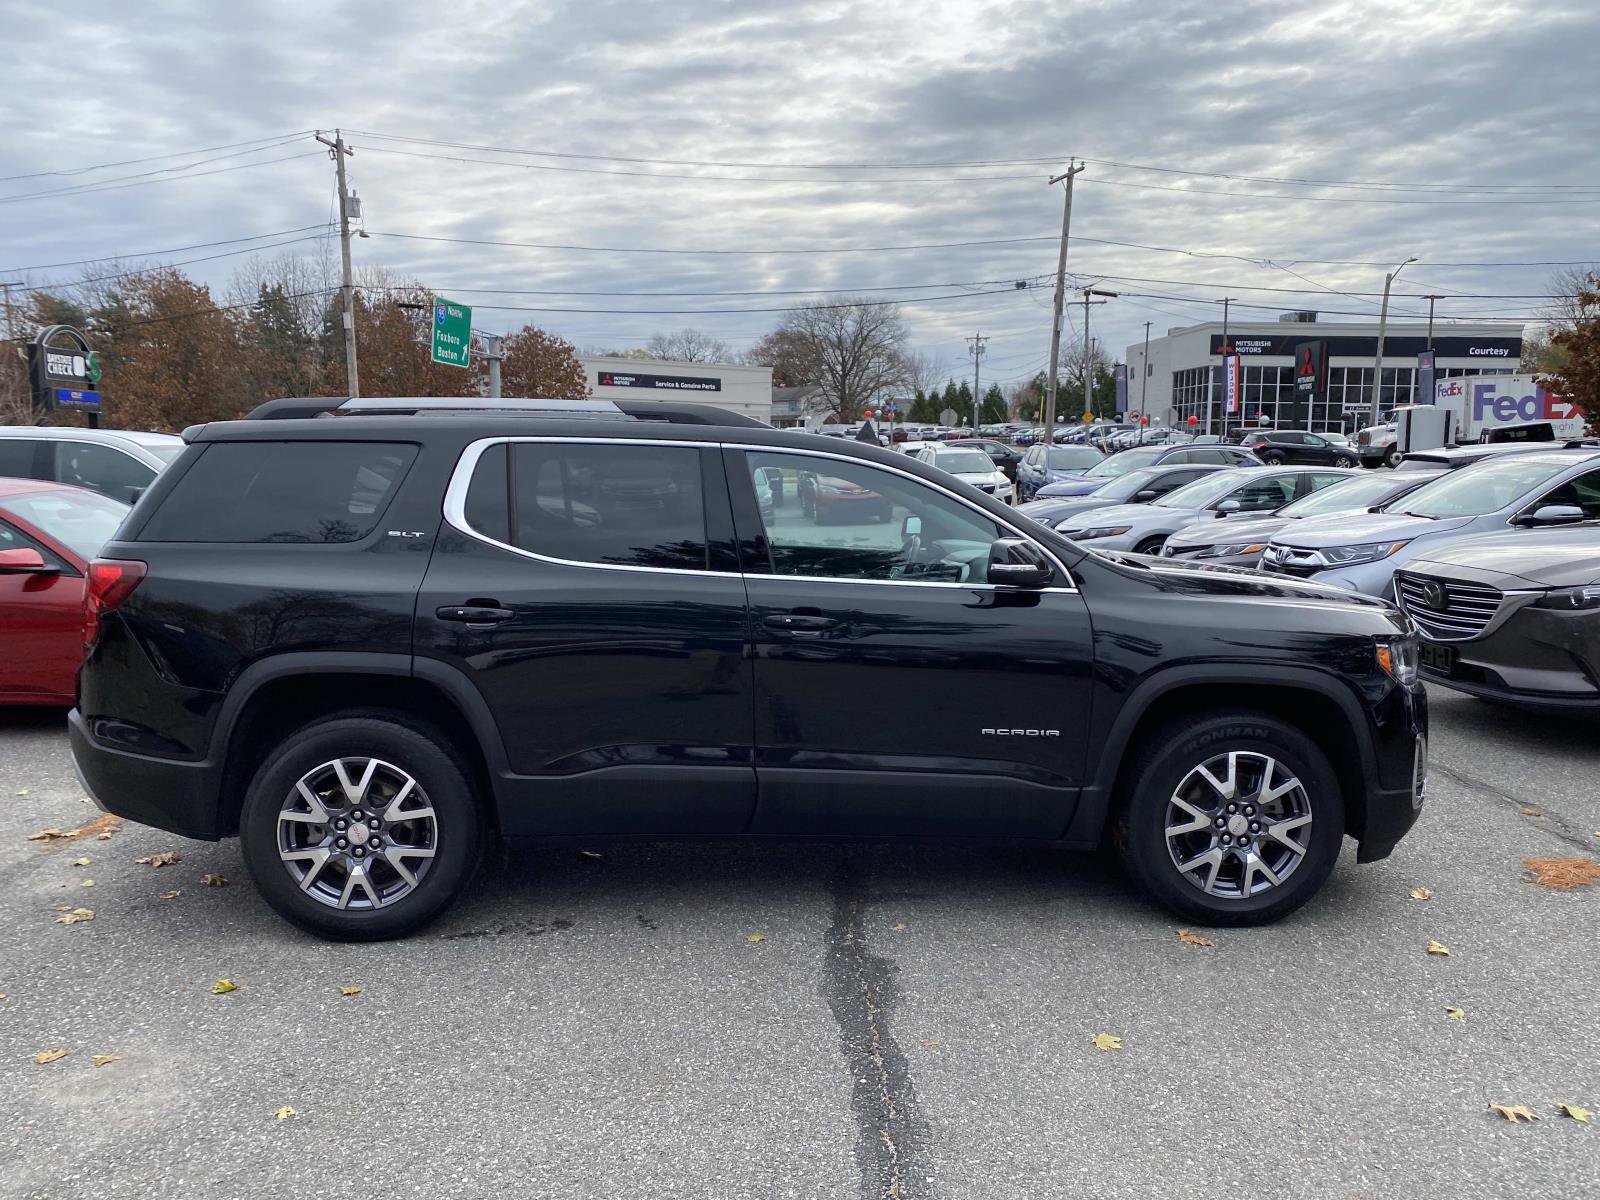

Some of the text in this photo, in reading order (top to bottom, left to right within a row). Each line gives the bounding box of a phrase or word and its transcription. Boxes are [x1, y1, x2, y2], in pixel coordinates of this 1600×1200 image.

[436, 330, 460, 345] Foxboro
[437, 346, 458, 361] Boston
[1469, 347, 1509, 356] Courtesy
[47, 363, 74, 376] CHECK
[1437, 382, 1463, 398] FedEx
[1473, 384, 1586, 421] FedEx
[388, 530, 425, 538] SLT
[981, 728, 1060, 737] ACADIA
